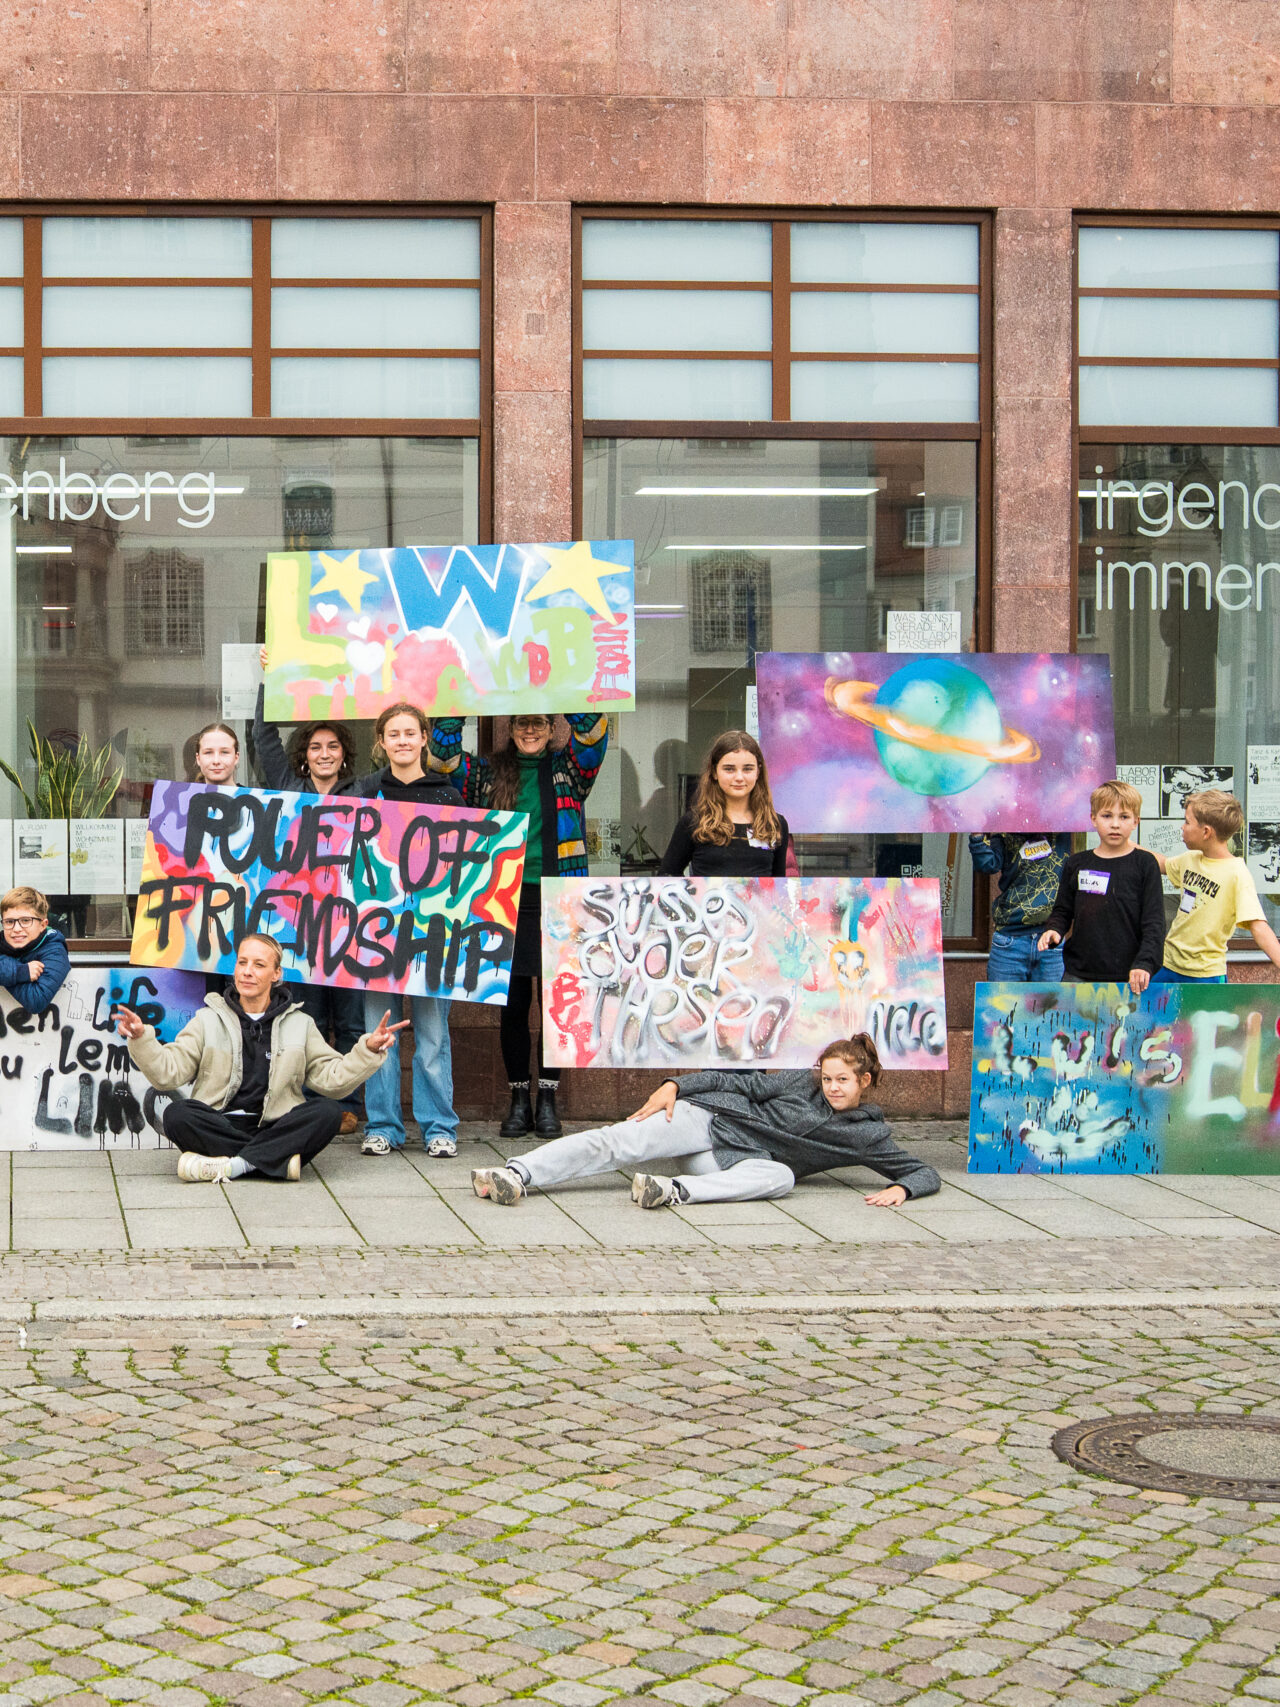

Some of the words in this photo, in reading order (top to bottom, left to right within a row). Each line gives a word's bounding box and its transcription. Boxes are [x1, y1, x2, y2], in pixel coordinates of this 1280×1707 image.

[380, 544, 534, 648] W
[893, 613, 916, 622] WAS
[920, 613, 955, 622] SONST
[895, 622, 936, 631] GERADE
[942, 622, 953, 631] IM
[889, 631, 958, 640] STADTLABOR
[184, 792, 382, 896] POWER
[399, 815, 501, 902] OF
